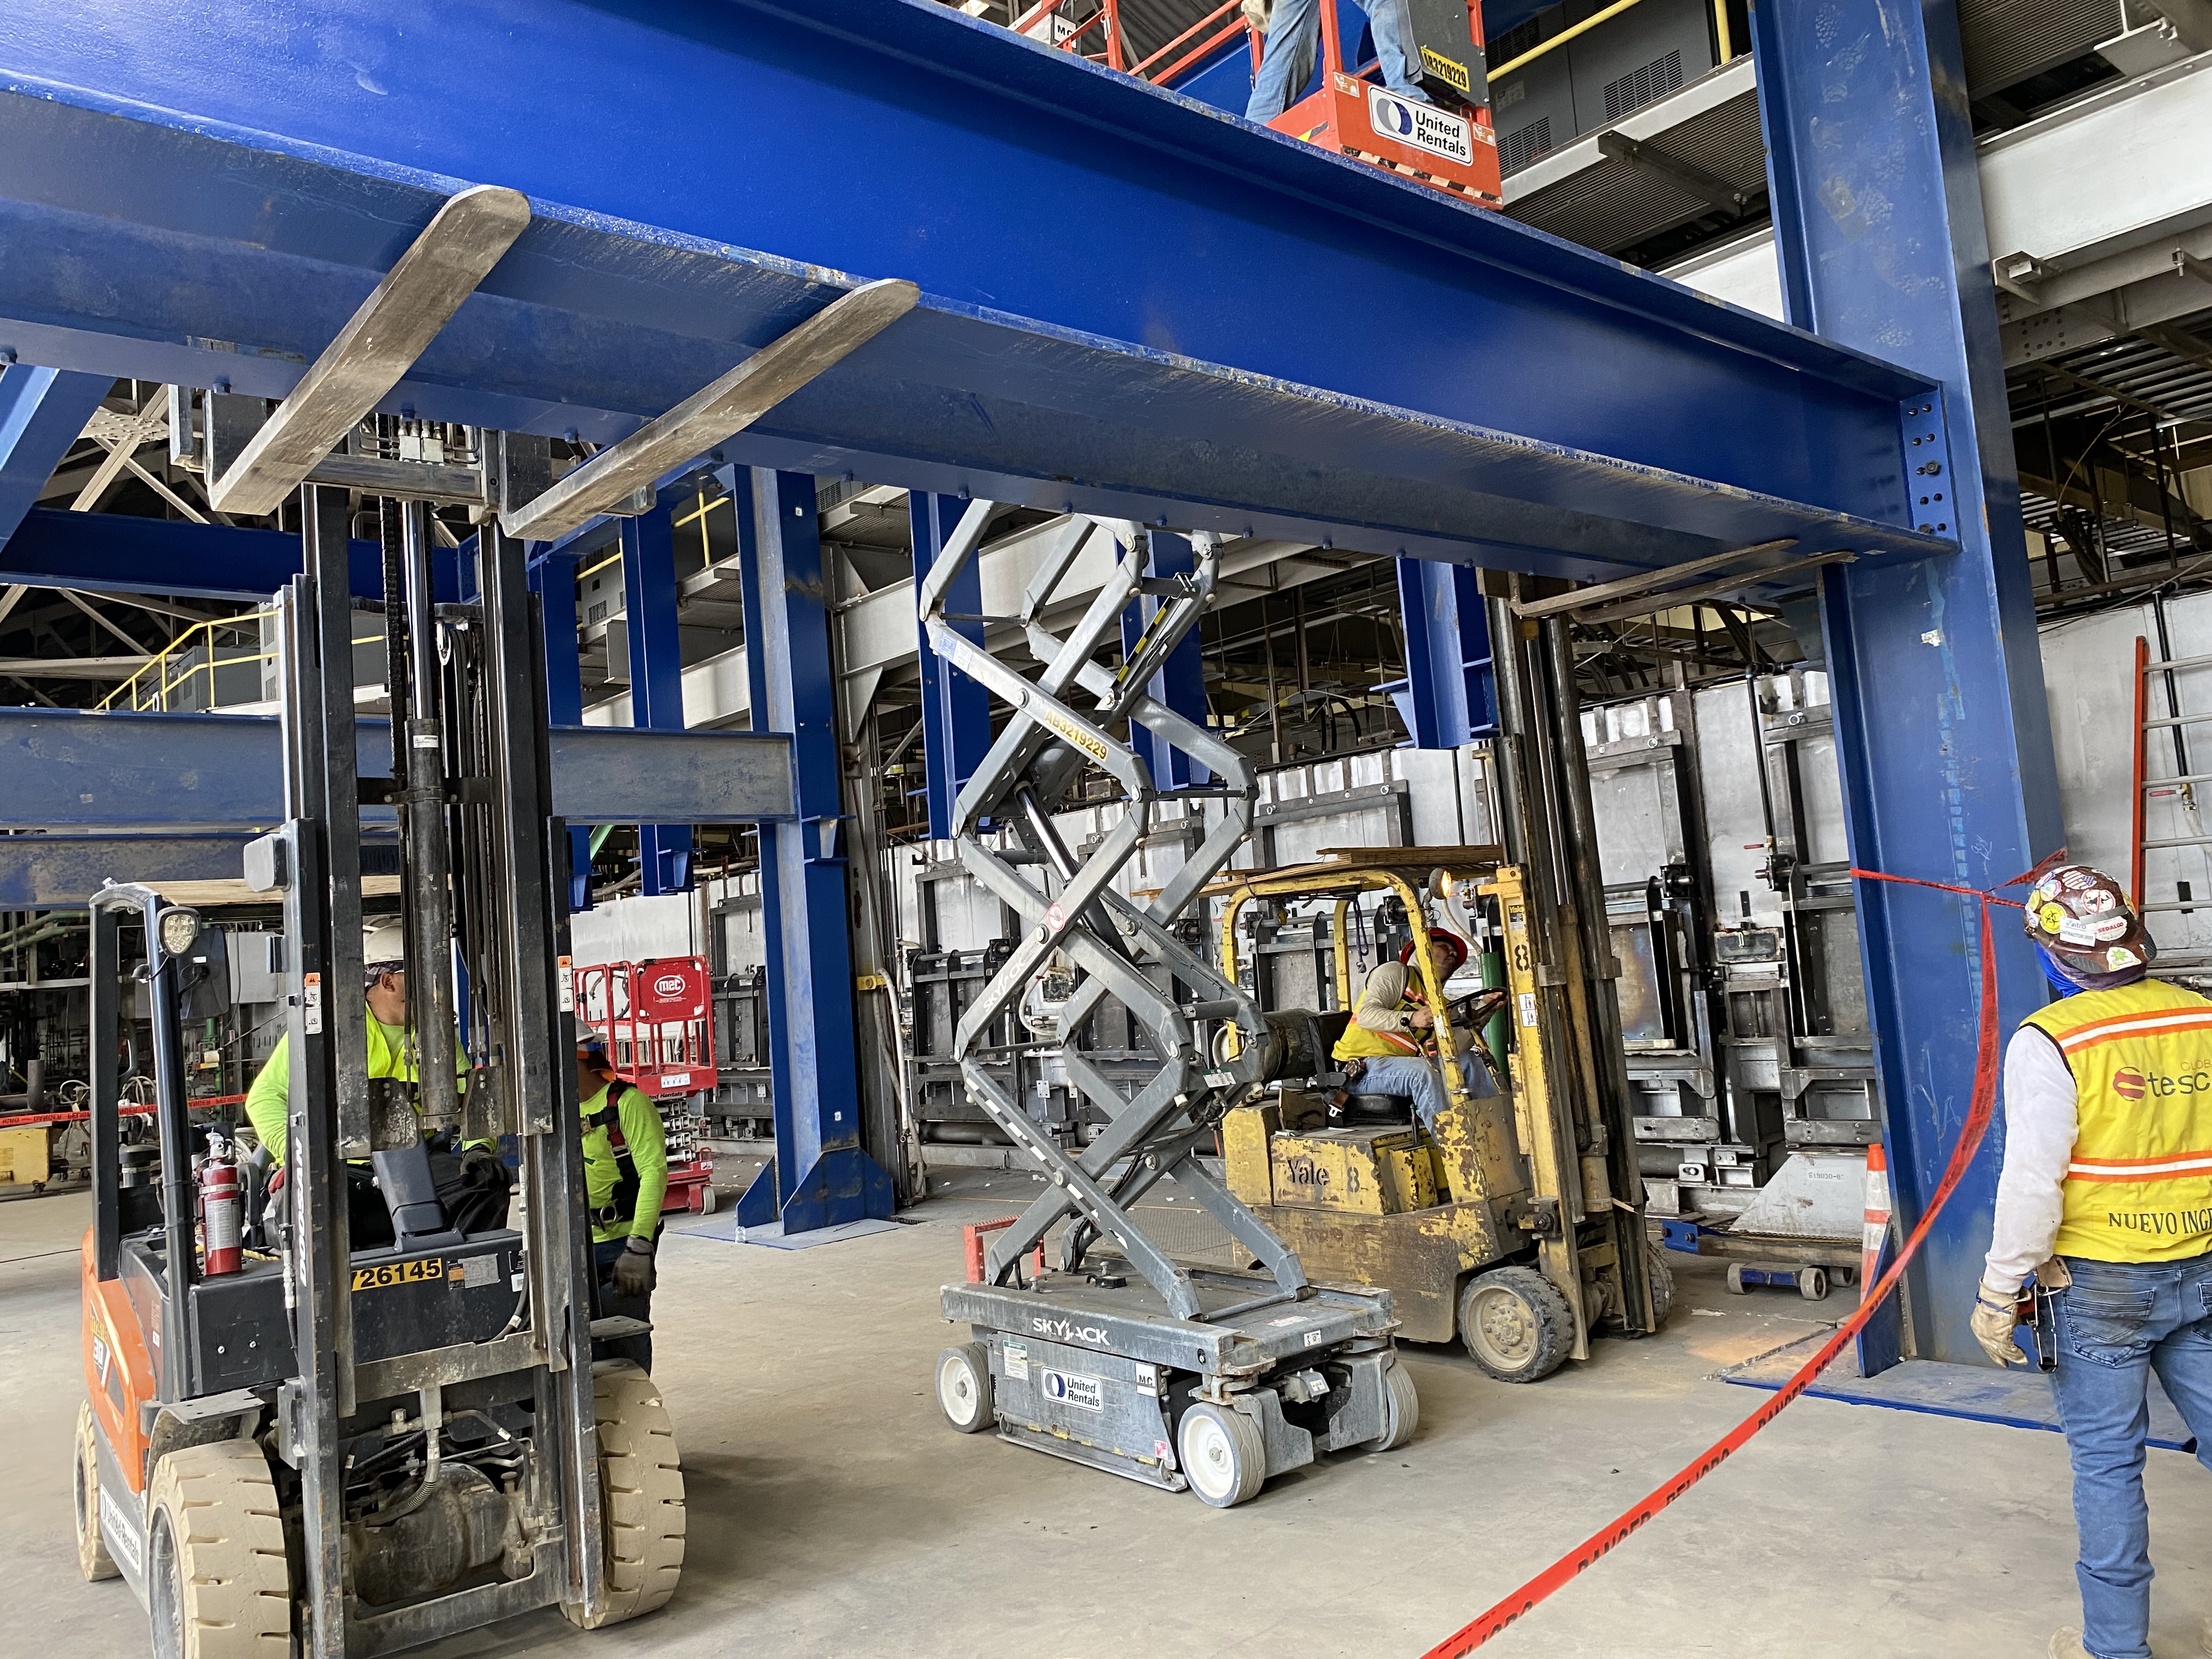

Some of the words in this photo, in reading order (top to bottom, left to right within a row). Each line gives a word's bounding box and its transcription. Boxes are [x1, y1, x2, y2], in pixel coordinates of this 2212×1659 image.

[1415, 110, 1460, 138] United
[1417, 127, 1466, 156] Rentals
[1044, 710, 1107, 759] AB3219229
[2097, 922, 2124, 933] SEDALCO
[1514, 944, 1530, 972] 8
[2181, 1059, 2212, 1071] GLOB
[1286, 1159, 1330, 1186] Yale
[1347, 1166, 1360, 1193] 8
[295, 1136, 308, 1287] DOOSAN
[2108, 1212, 2177, 1235] NUEVO
[1032, 1317, 1110, 1346] SKYJACK
[1067, 1377, 1096, 1394] United
[1138, 1374, 1153, 1386] MC
[1068, 1390, 1100, 1407] Rentals
